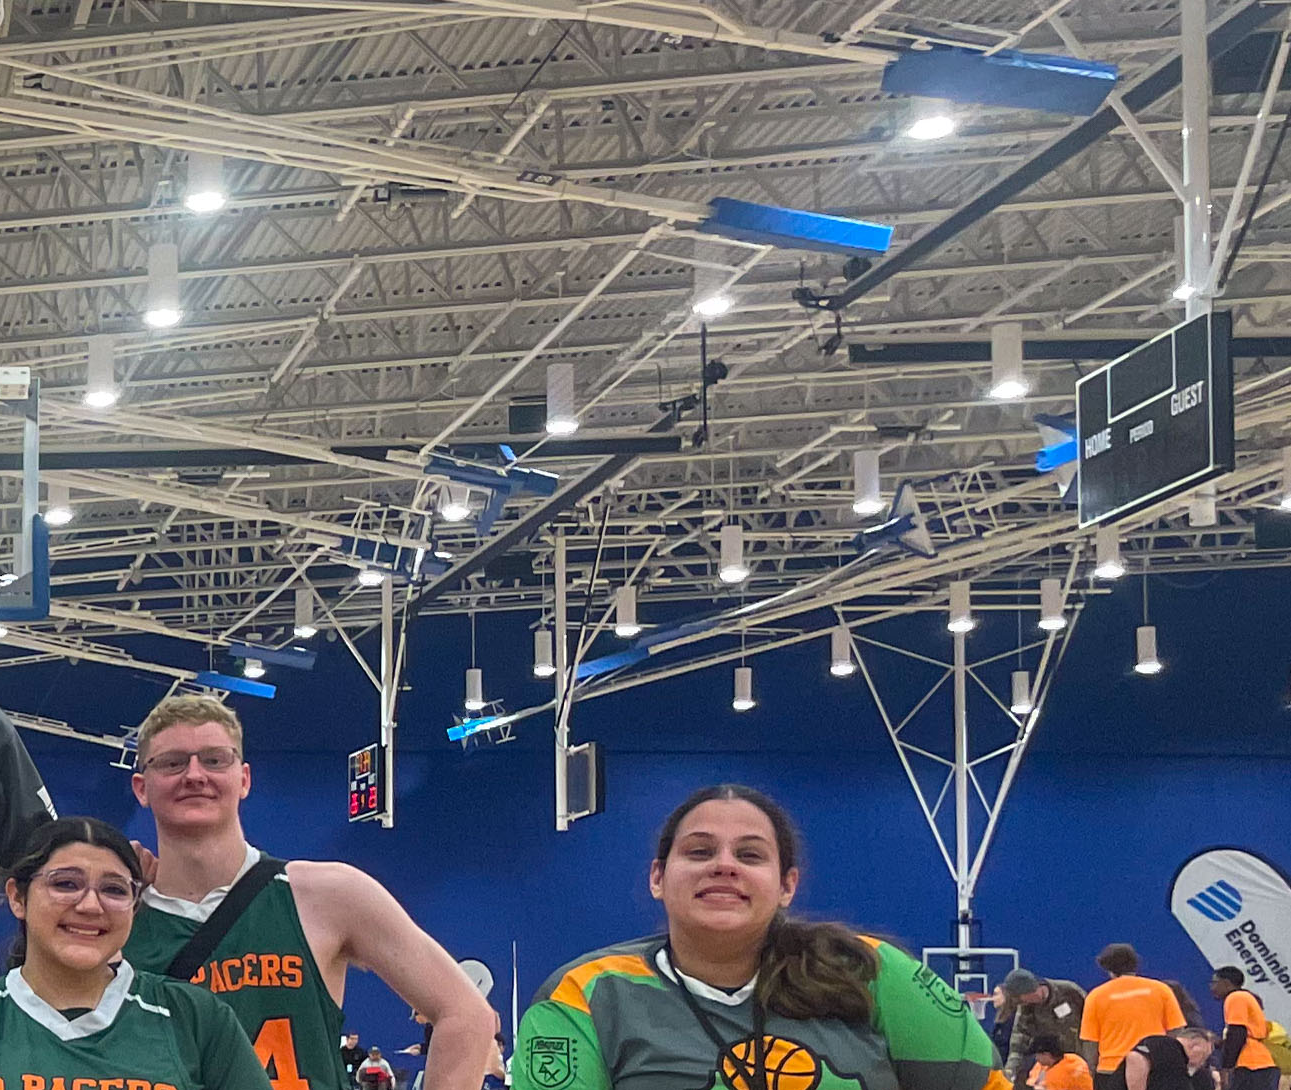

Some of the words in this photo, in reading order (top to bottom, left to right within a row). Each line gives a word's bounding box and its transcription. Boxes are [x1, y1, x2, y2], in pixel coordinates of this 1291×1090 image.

[1170, 380, 1205, 417] GUEST
[1085, 427, 1113, 460] HOME
[1225, 928, 1270, 984] Energy
